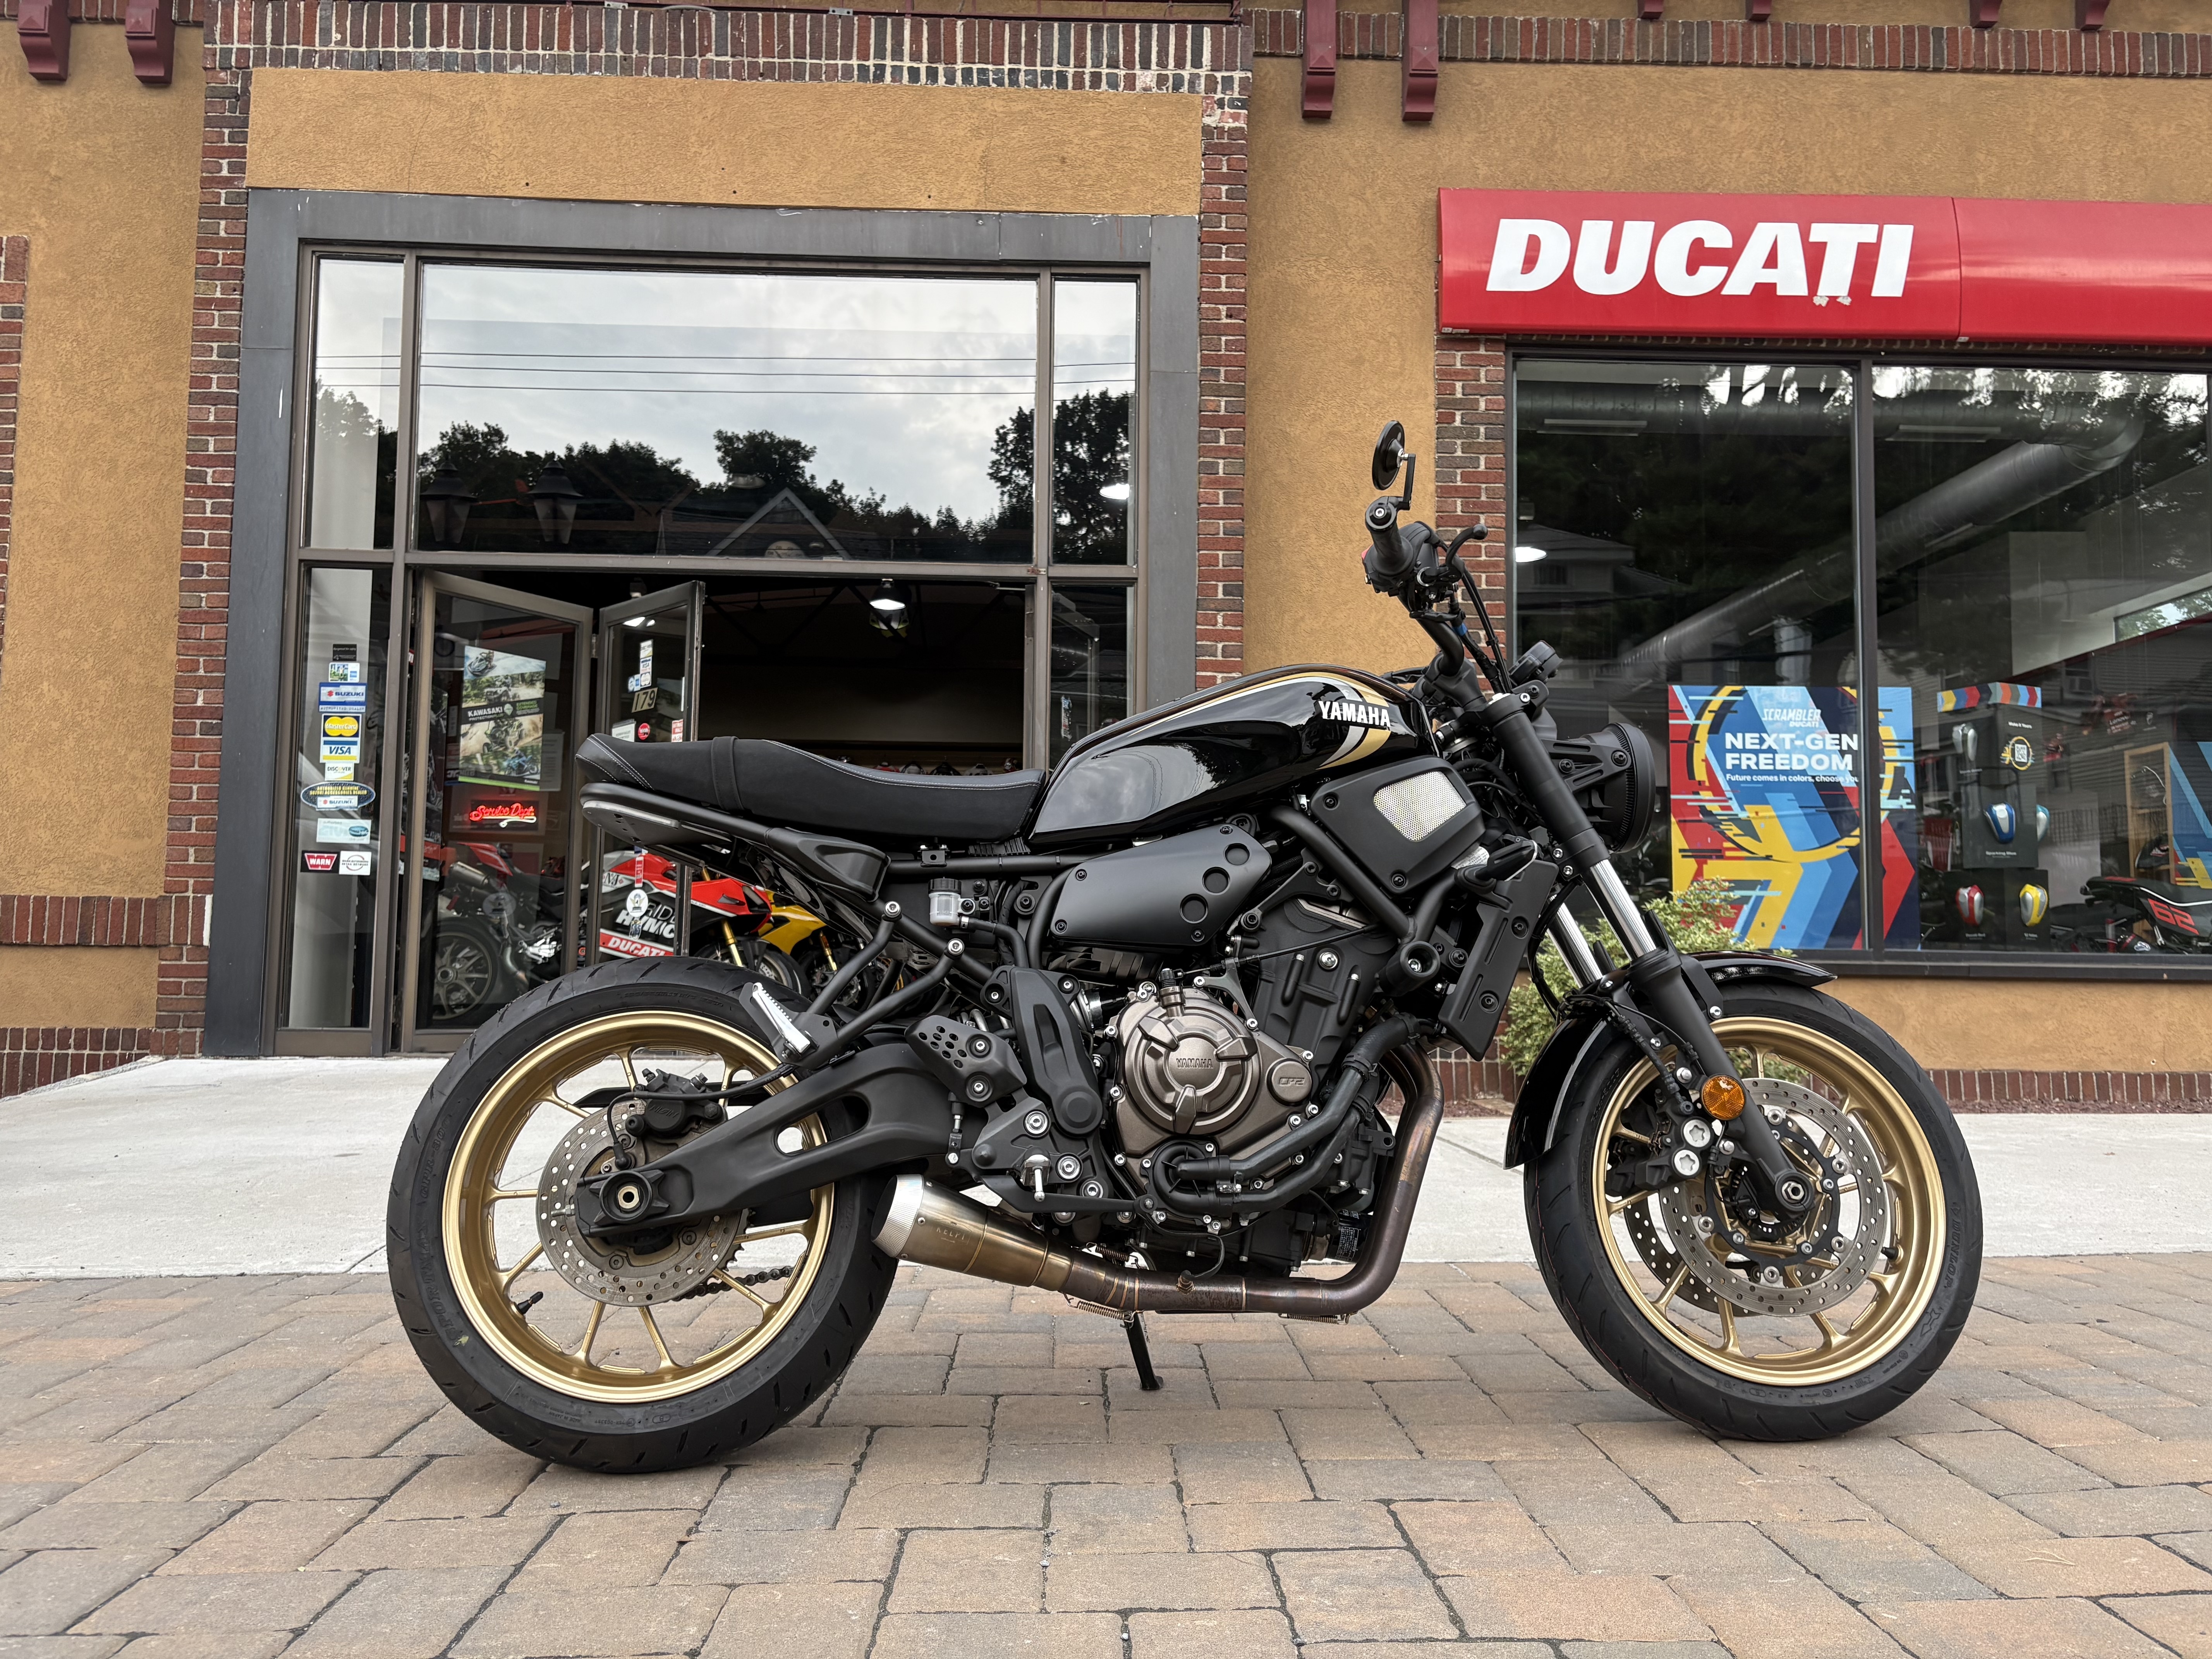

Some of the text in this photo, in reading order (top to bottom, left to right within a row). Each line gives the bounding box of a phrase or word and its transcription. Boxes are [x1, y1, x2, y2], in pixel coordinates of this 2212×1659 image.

[1486, 218, 1914, 297] DUCATI
[634, 690, 656, 711] 179
[468, 706, 503, 717] KAWASAKI
[1318, 701, 1391, 727] YAMAHA
[1762, 708, 1821, 721] SCRAMBLER
[329, 746, 351, 754] VISA
[1725, 732, 1858, 750] NEXT-GEN
[1726, 752, 1853, 771] FREEDOM
[1788, 774, 1815, 783] colors,
[469, 805, 510, 821] Service
[2148, 898, 2200, 935] 62
[1176, 1058, 1214, 1069] YAMAHA
[1944, 1219, 1961, 1288] DUNLOP
